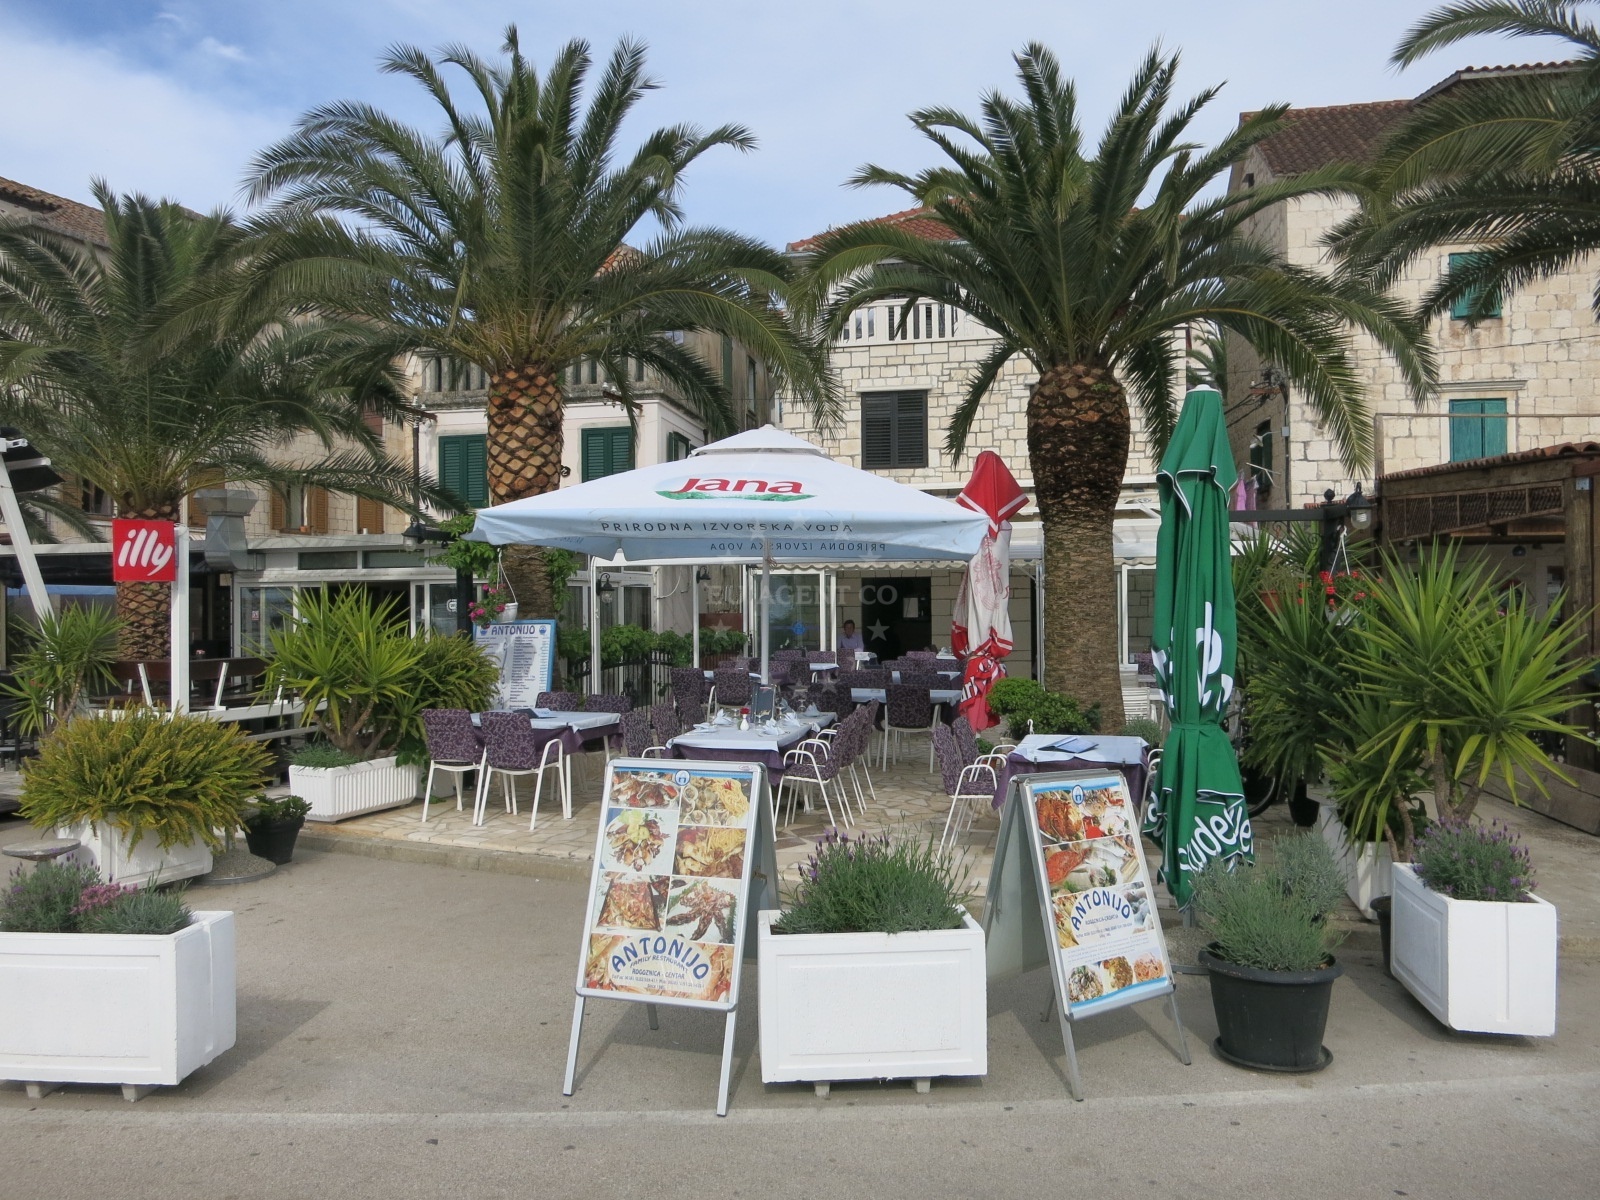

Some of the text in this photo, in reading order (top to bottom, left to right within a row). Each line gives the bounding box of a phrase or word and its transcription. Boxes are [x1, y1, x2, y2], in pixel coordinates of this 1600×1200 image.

[601, 522, 854, 533] PRIRODNA IZVORSKA VODA
[118, 528, 173, 577] illy
[491, 625, 536, 636] ANTONIJO
[1071, 889, 1131, 931] ANTONIJO
[611, 936, 709, 980] ANTONIJO
[629, 955, 651, 969] FAMILY
[664, 971, 685, 980] CENTAR
